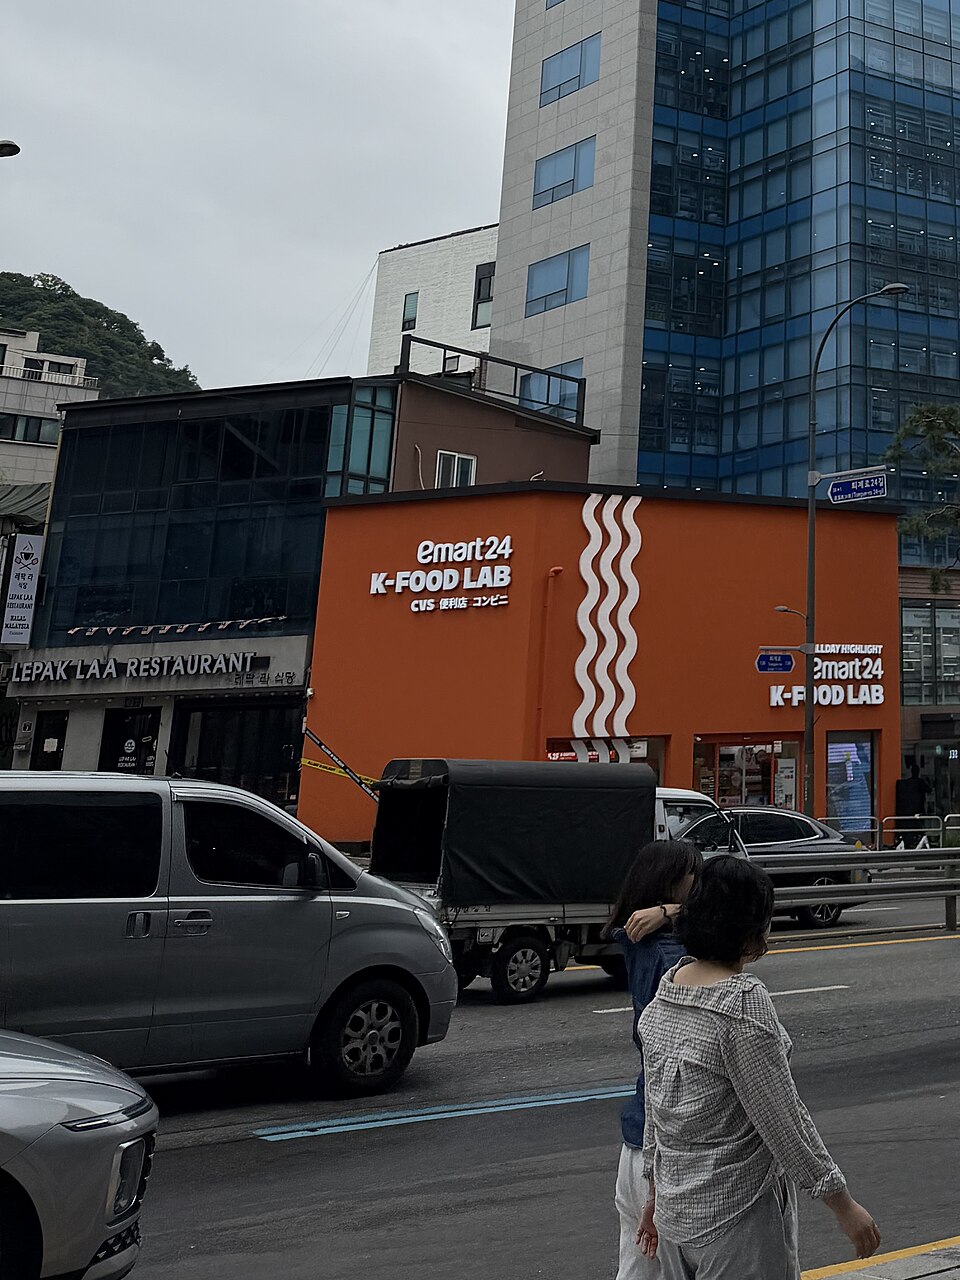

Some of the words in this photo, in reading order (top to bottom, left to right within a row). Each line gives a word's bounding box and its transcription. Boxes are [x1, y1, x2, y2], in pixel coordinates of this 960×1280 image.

[417, 535, 513, 564] emart24
[370, 568, 460, 595] K-FOOD
[463, 565, 512, 590] LAB
[410, 598, 435, 612] CVS
[439, 596, 468, 611] 便利店
[472, 593, 509, 607] コンビニ
[815, 643, 840, 654] LLDAY
[11, 660, 72, 683] LEPAK
[76, 658, 118, 681] LAA
[126, 651, 256, 678] RESTAURANT
[847, 684, 884, 705] LAB
